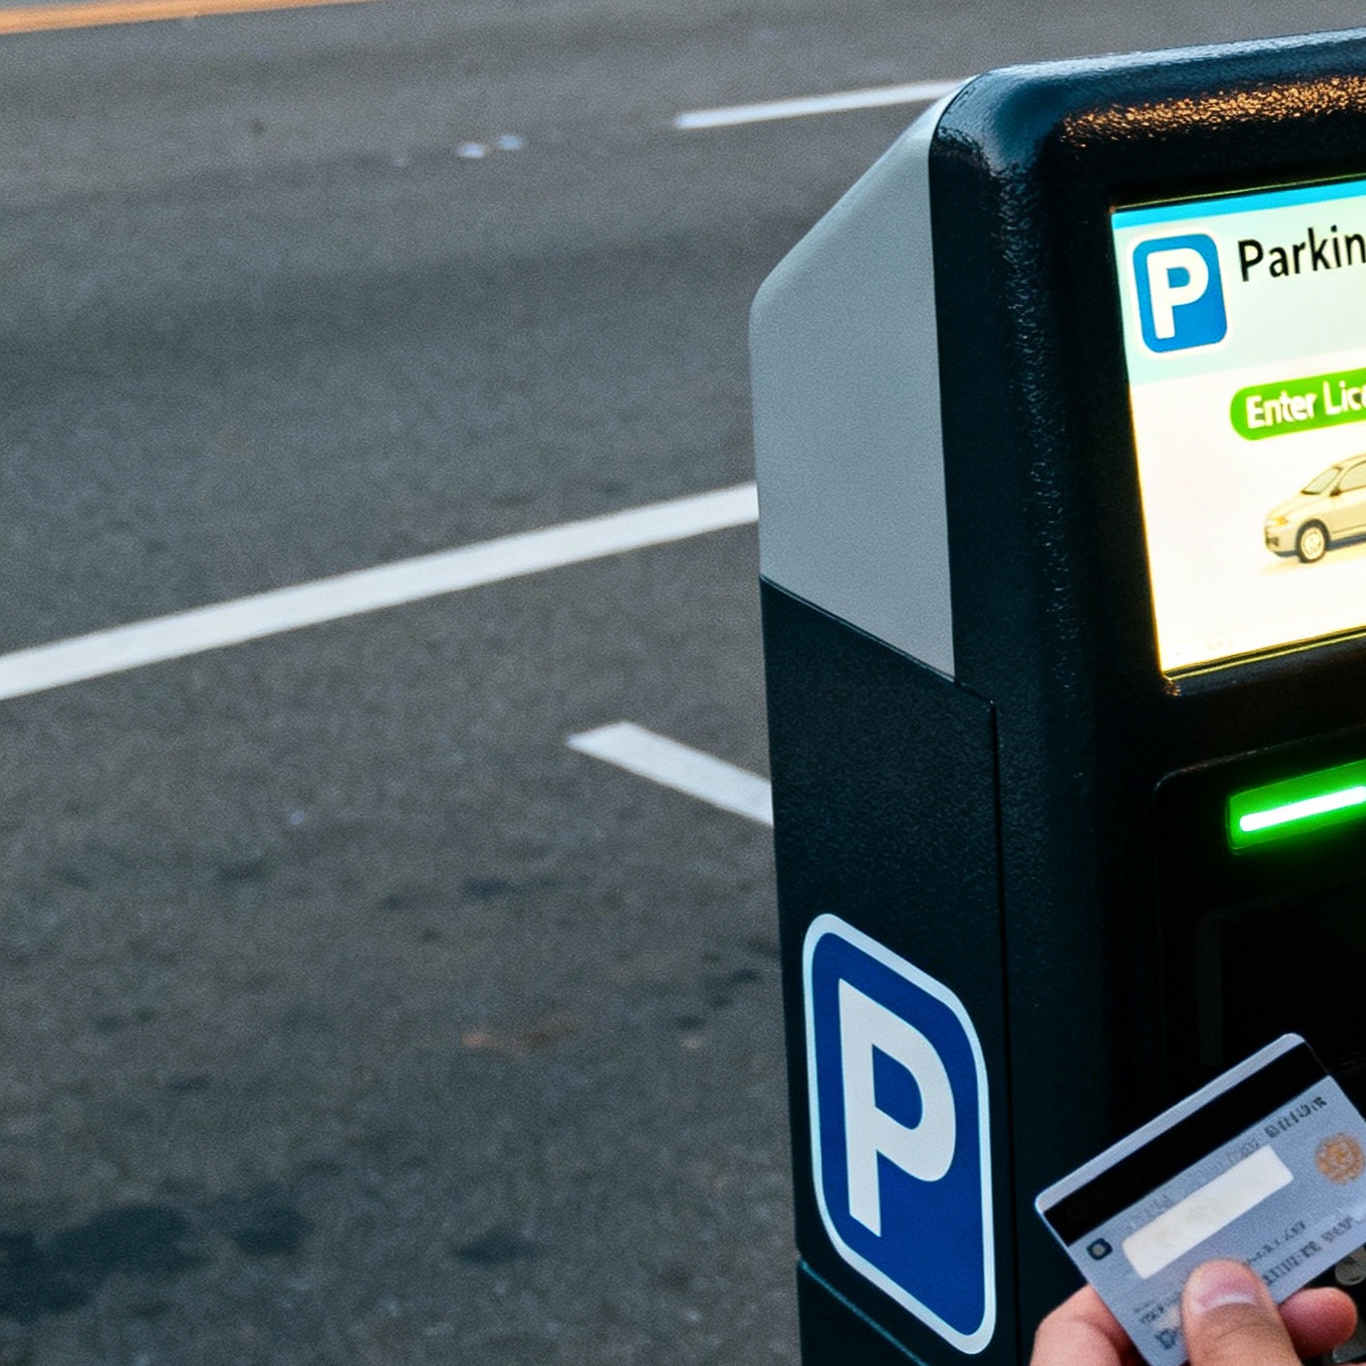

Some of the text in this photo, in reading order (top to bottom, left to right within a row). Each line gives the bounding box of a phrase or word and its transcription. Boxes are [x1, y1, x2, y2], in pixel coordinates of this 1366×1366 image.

[1146, 247, 1210, 340] P
[1245, 389, 1317, 429] Enter
[838, 978, 957, 1237] P
